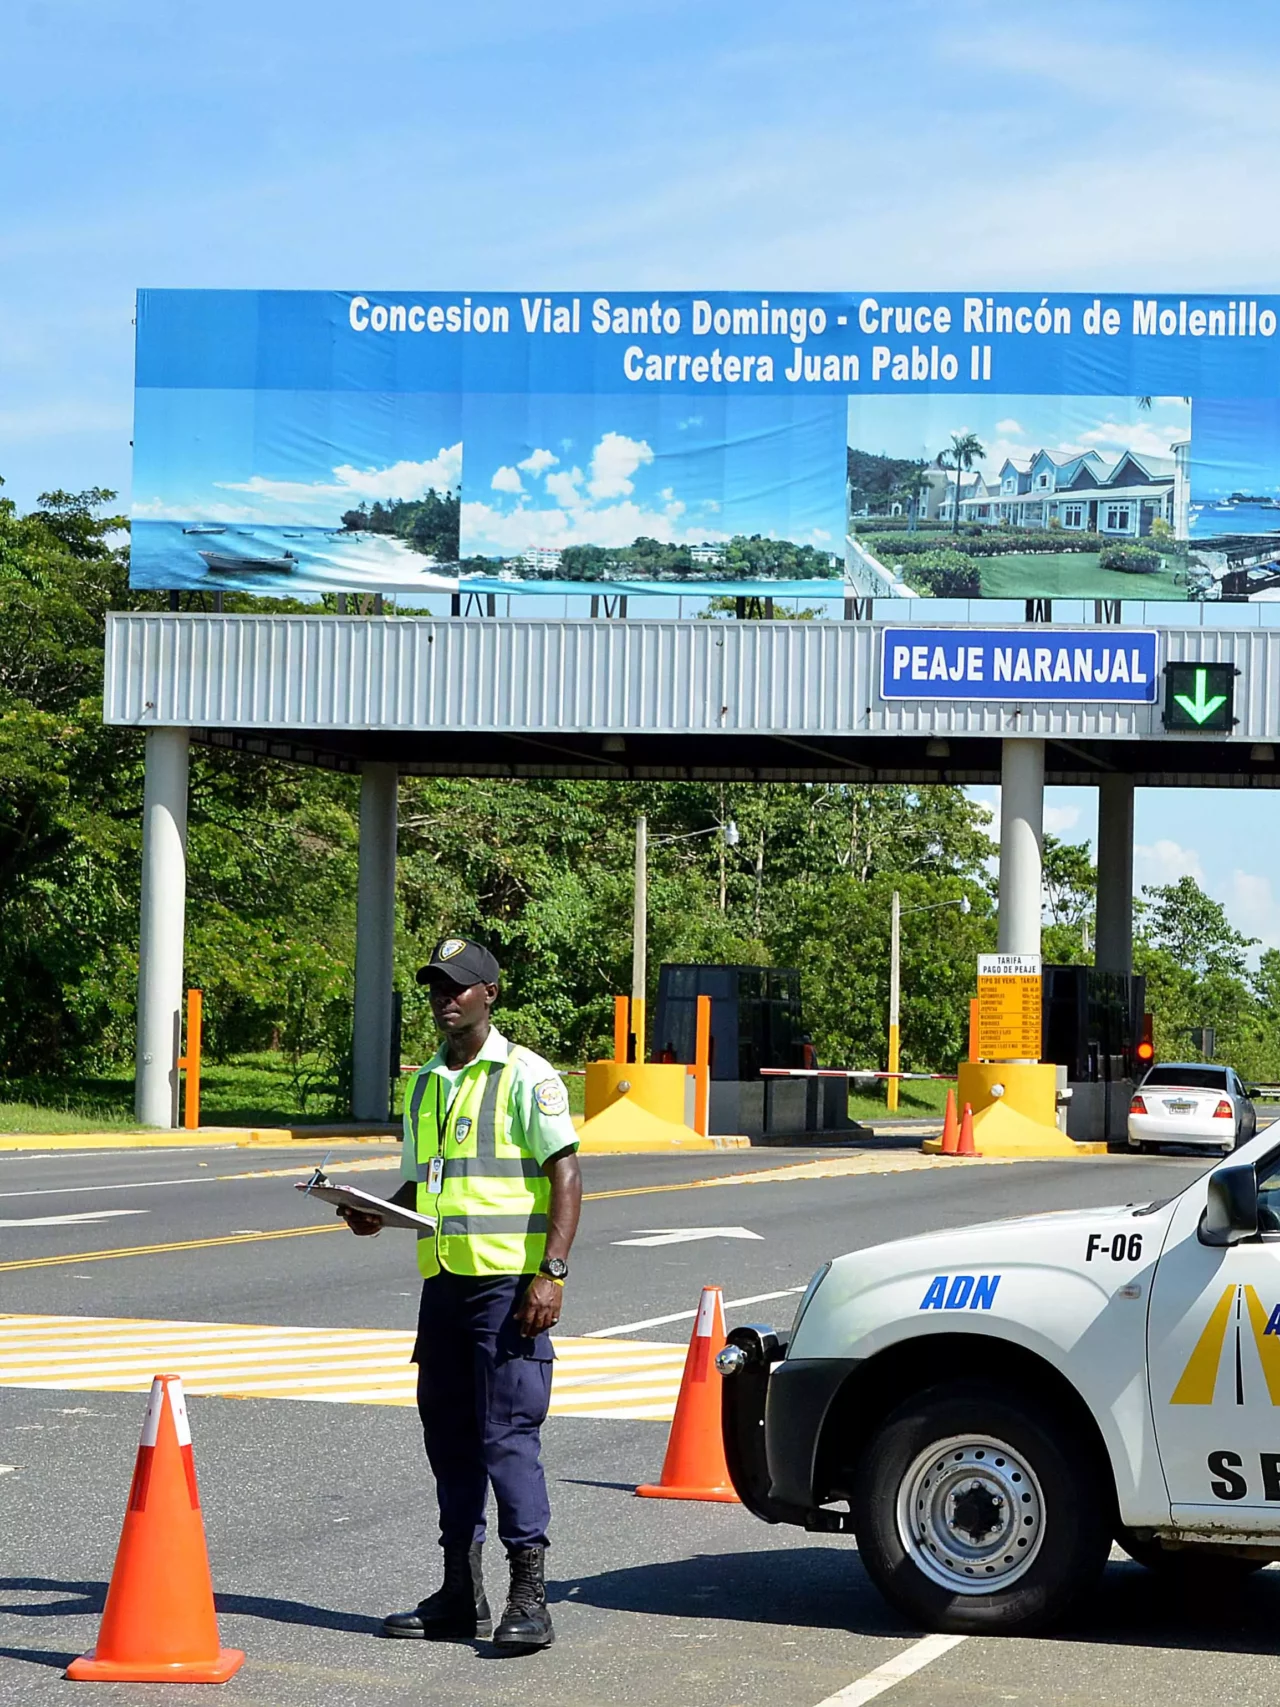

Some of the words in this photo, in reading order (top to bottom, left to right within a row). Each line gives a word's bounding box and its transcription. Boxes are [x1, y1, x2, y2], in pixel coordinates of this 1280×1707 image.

[349, 296, 509, 333] Concesion
[520, 298, 580, 333] Vial
[592, 298, 681, 334] Santo
[692, 300, 827, 343] Domingo
[858, 297, 951, 334] Cruce
[964, 298, 1071, 334] Rincón
[1083, 300, 1121, 335] de
[1132, 300, 1277, 336] Molenillo
[623, 346, 774, 383] Carretera
[785, 346, 859, 382] Juan
[872, 346, 958, 382] Pablo
[971, 345, 991, 381] II
[893, 645, 983, 682] PEAJE
[993, 647, 1147, 684] NARANJAL
[983, 965, 1001, 974] PAGO
[1003, 965, 1012, 974] DE
[1014, 965, 1036, 974] PEAJE
[997, 956, 1022, 964] TARIFA
[1086, 1233, 1143, 1262] F-06
[919, 1275, 1001, 1310] ADN
